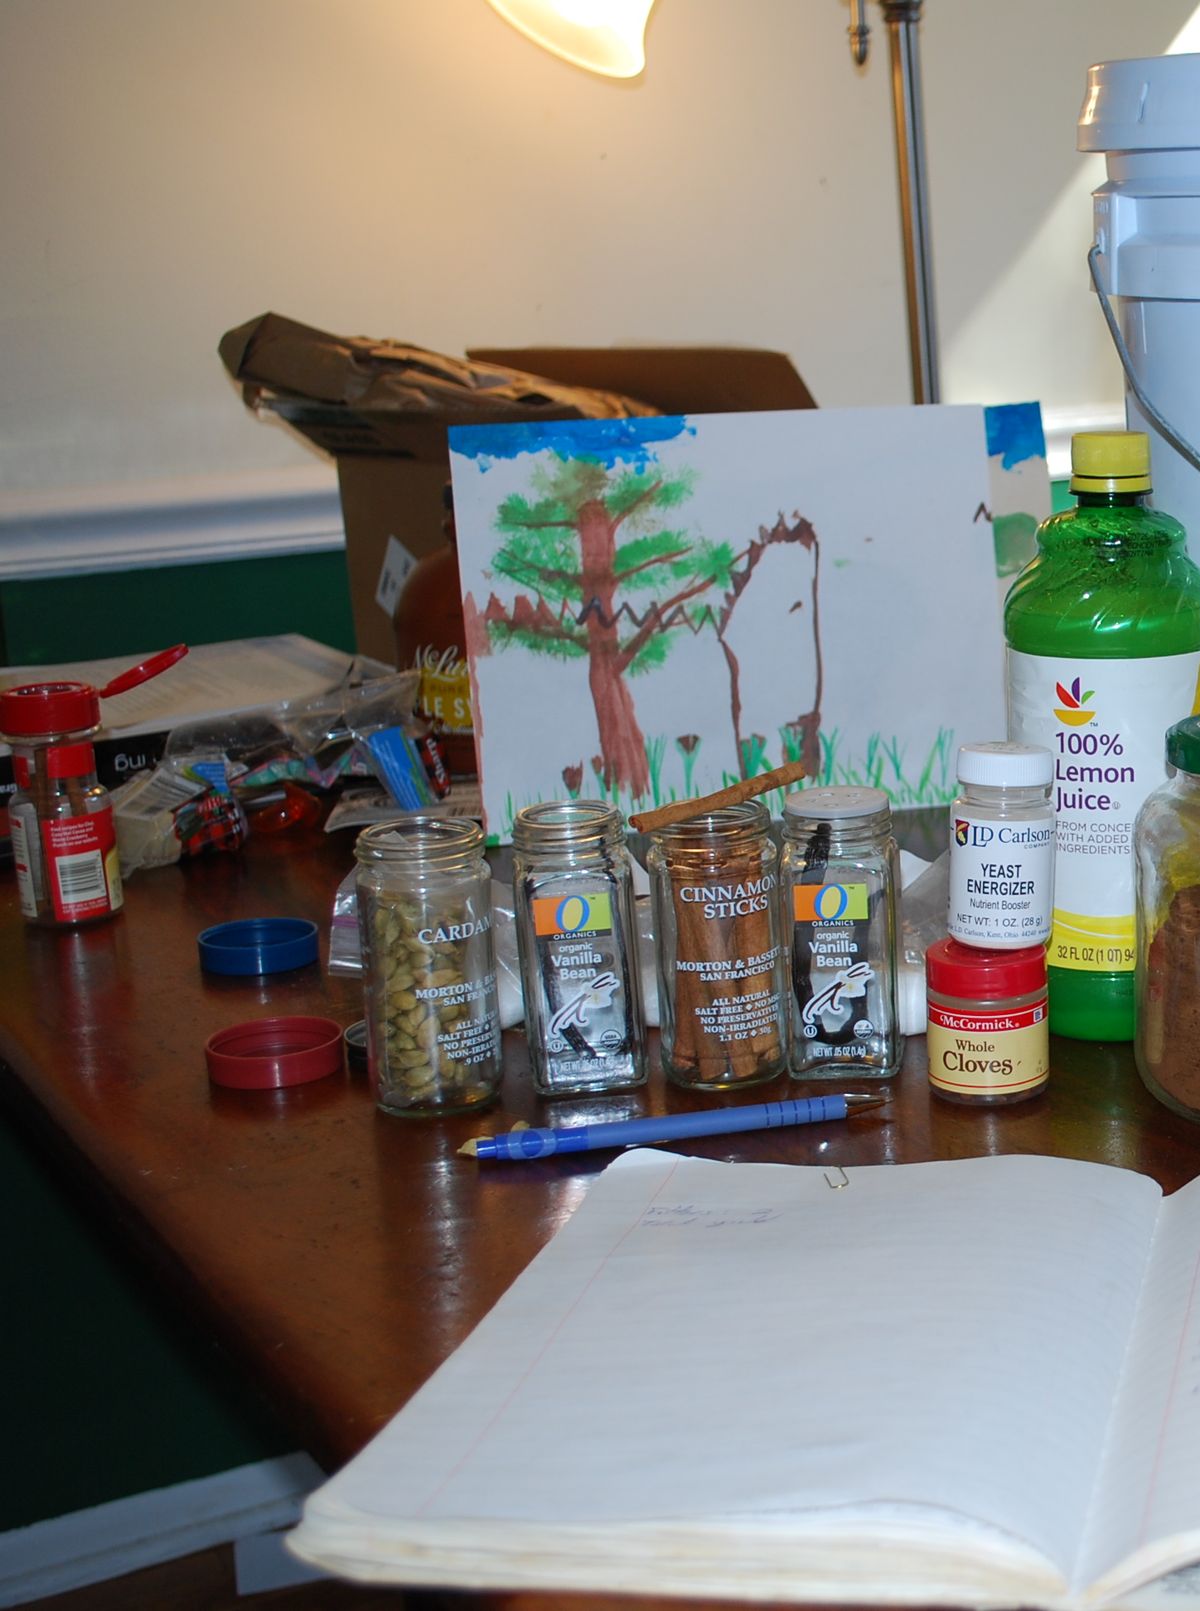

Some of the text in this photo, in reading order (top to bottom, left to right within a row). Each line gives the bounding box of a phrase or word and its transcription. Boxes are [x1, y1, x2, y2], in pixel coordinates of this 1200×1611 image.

[1056, 732, 1124, 756] 100%
[1056, 758, 1135, 783] Lemon
[1056, 786, 1111, 812] Juice
[1056, 820, 1087, 832] FROM
[999, 827, 1050, 843] Carlson
[1056, 831, 1129, 844] WITH ADDED
[1056, 843, 1131, 855] INGREDIENTS
[981, 863, 1022, 878] YEAST
[680, 872, 777, 903] CINNAMON
[967, 879, 1035, 895] ENERGIZER
[704, 894, 768, 919] STICKS
[969, 898, 1031, 910] Nutrient Booster
[957, 913, 972, 924] NET
[1021, 917, 1035, 928] (28
[1035, 916, 1043, 927] g)
[553, 931, 597, 941] ORGANICS
[816, 931, 850, 940] organic
[559, 942, 593, 954] organic
[808, 942, 858, 953] Vanilla
[1057, 945, 1068, 959] 32
[1070, 947, 1080, 960] FL
[1082, 948, 1094, 961] OZ
[1096, 948, 1104, 963] (1
[1106, 948, 1123, 963] QT)
[551, 952, 602, 967] Vanilla
[676, 959, 745, 972] MORTON &
[816, 955, 852, 967] Bean
[560, 967, 597, 980] Bean
[700, 961, 775, 982] SAN FRANCISCO
[416, 982, 472, 1000] MORTON
[712, 989, 770, 1006] ALL NATURAL
[443, 994, 464, 1006] SAN
[695, 1007, 718, 1016] SALT
[720, 1005, 743, 1014] FREE
[754, 1000, 767, 1009] NO
[701, 1002, 779, 1024] NO PRESERVATIVES
[456, 1021, 472, 1030] ALL
[704, 1012, 778, 1033] NON-IRRADIATED
[940, 1014, 1014, 1030] McCormick
[438, 1027, 482, 1042] SALT FREE
[719, 1031, 748, 1042] 1.1 OZ
[444, 1042, 458, 1051] NO
[955, 1039, 995, 1052] Whole
[473, 1053, 485, 1063] OZ
[943, 1050, 1013, 1075] Cloves
